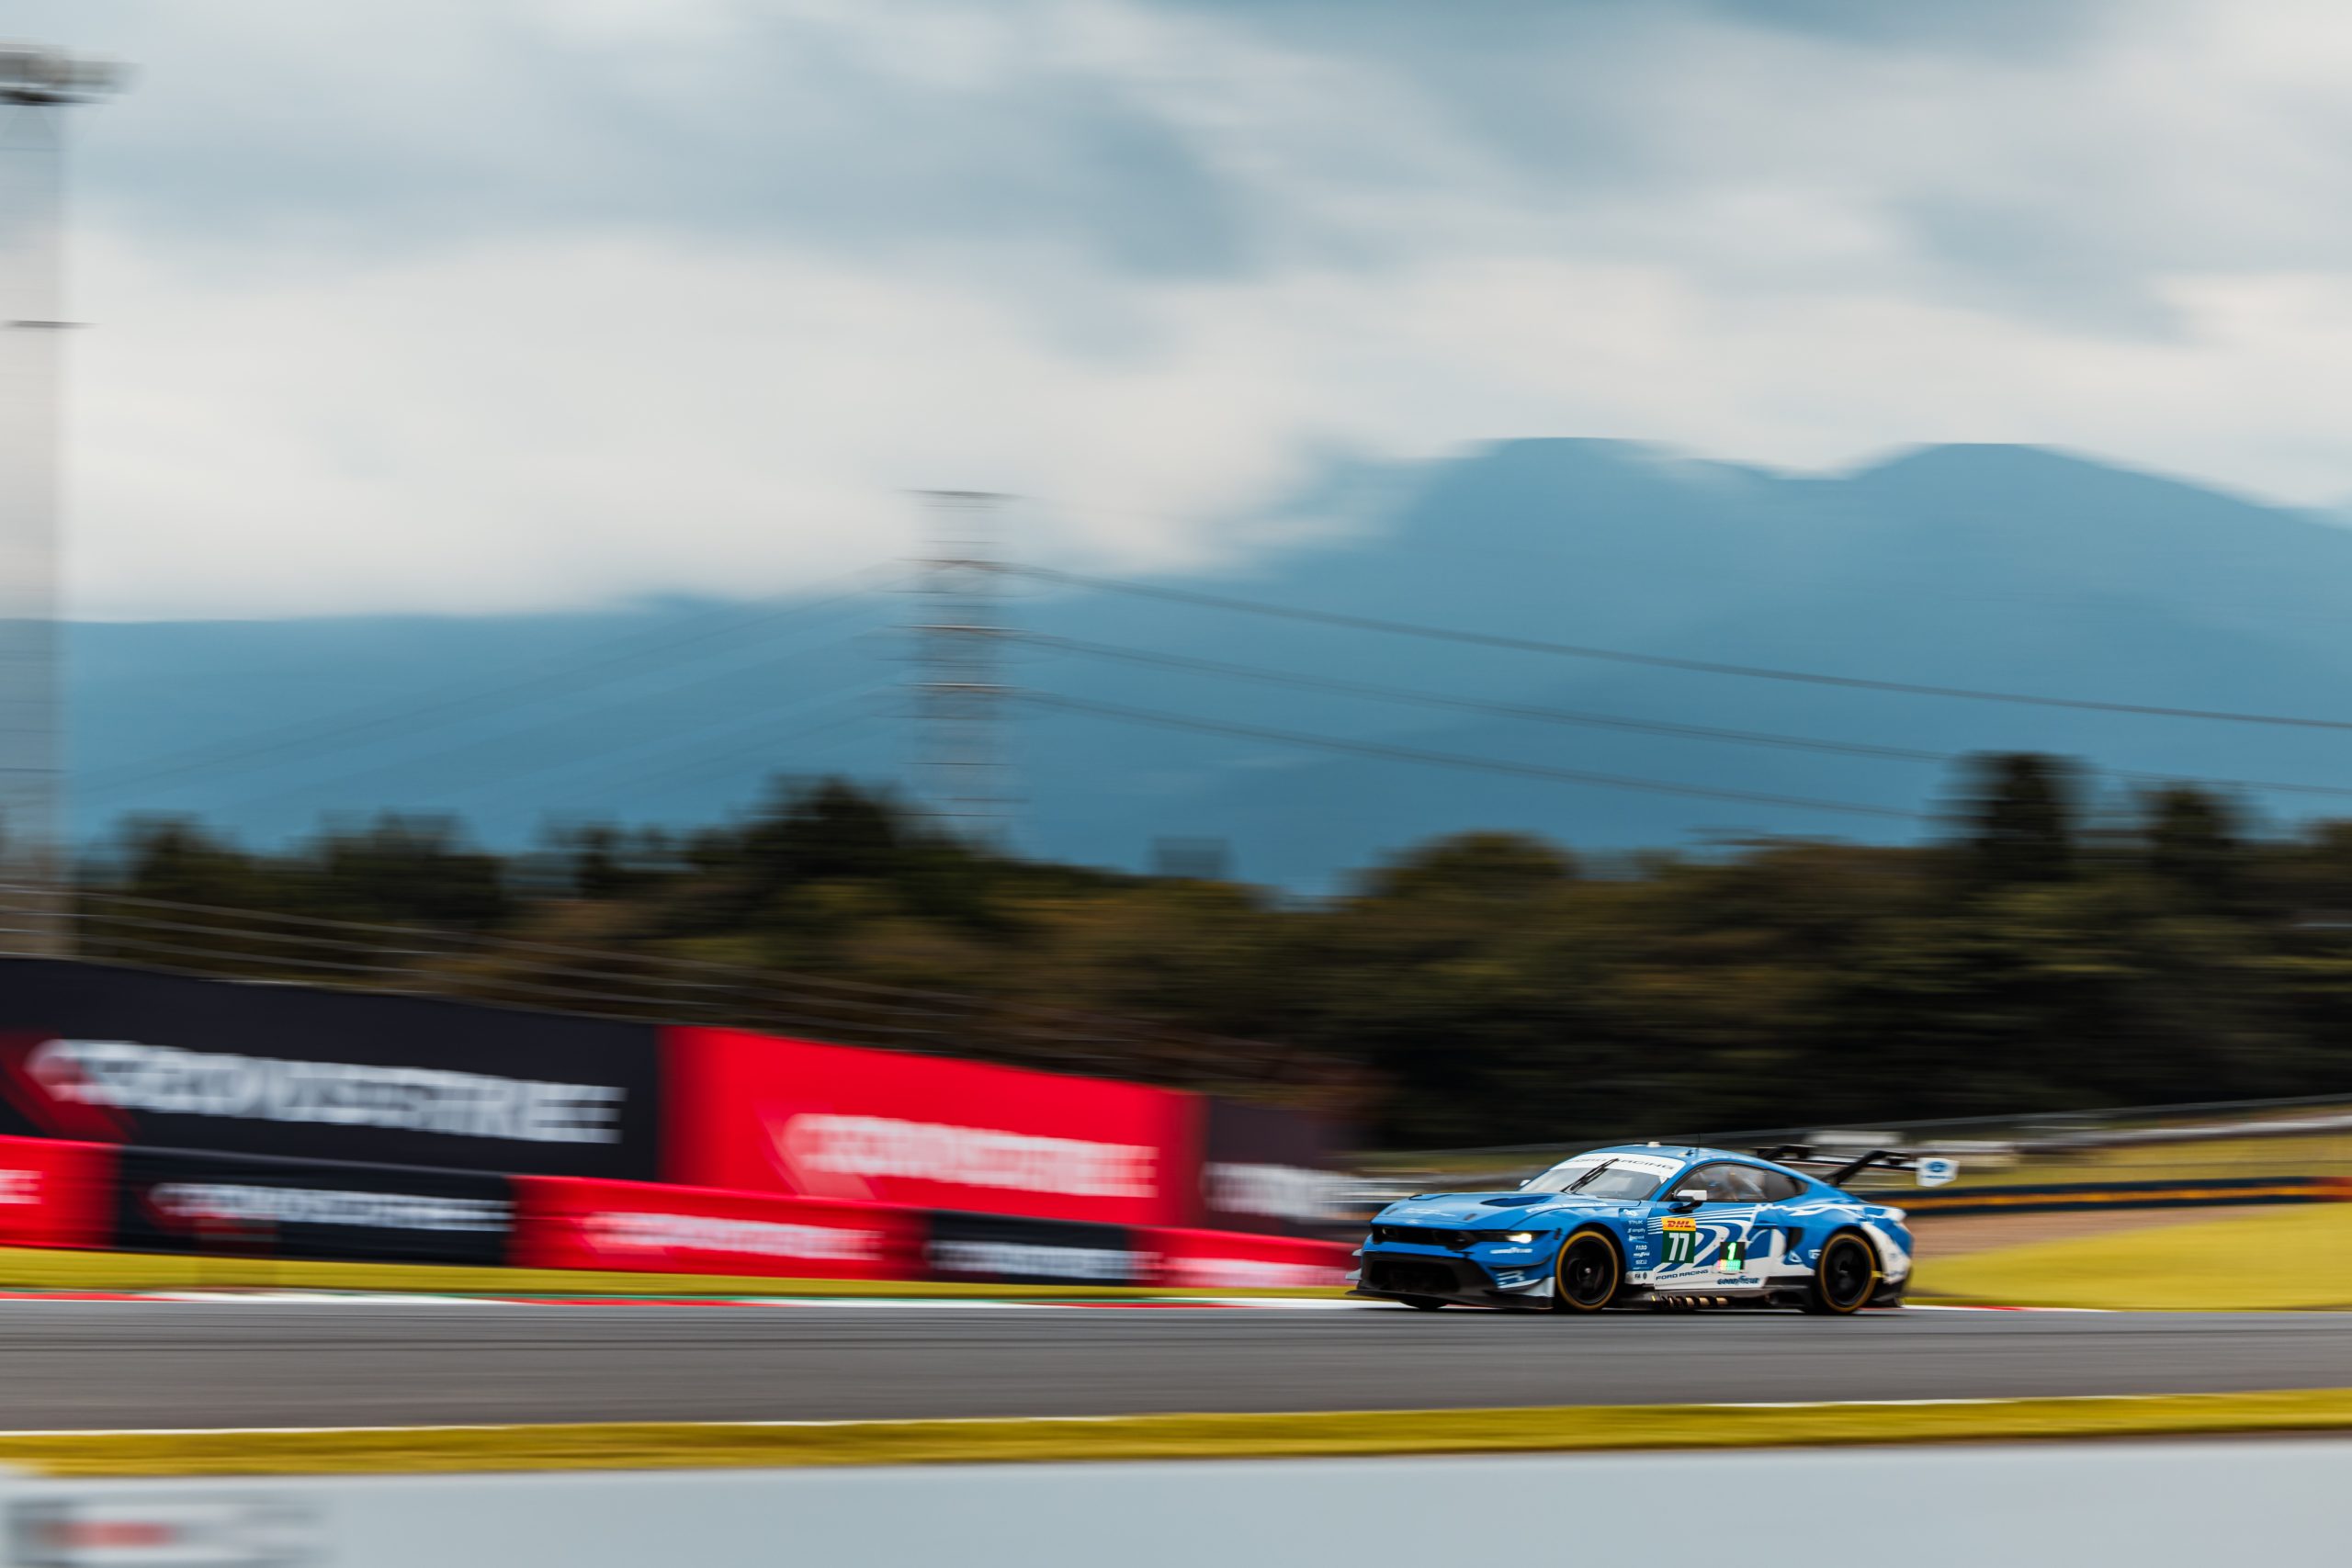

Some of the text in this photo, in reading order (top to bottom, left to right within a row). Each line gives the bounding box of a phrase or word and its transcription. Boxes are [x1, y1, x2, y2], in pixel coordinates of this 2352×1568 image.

[1616, 1158, 1674, 1170] ACING
[1667, 1220, 1691, 1228] DHL
[1668, 1232, 1690, 1261] 77
[1727, 1242, 1737, 1260] 1
[1679, 1269, 1709, 1278] RACING
